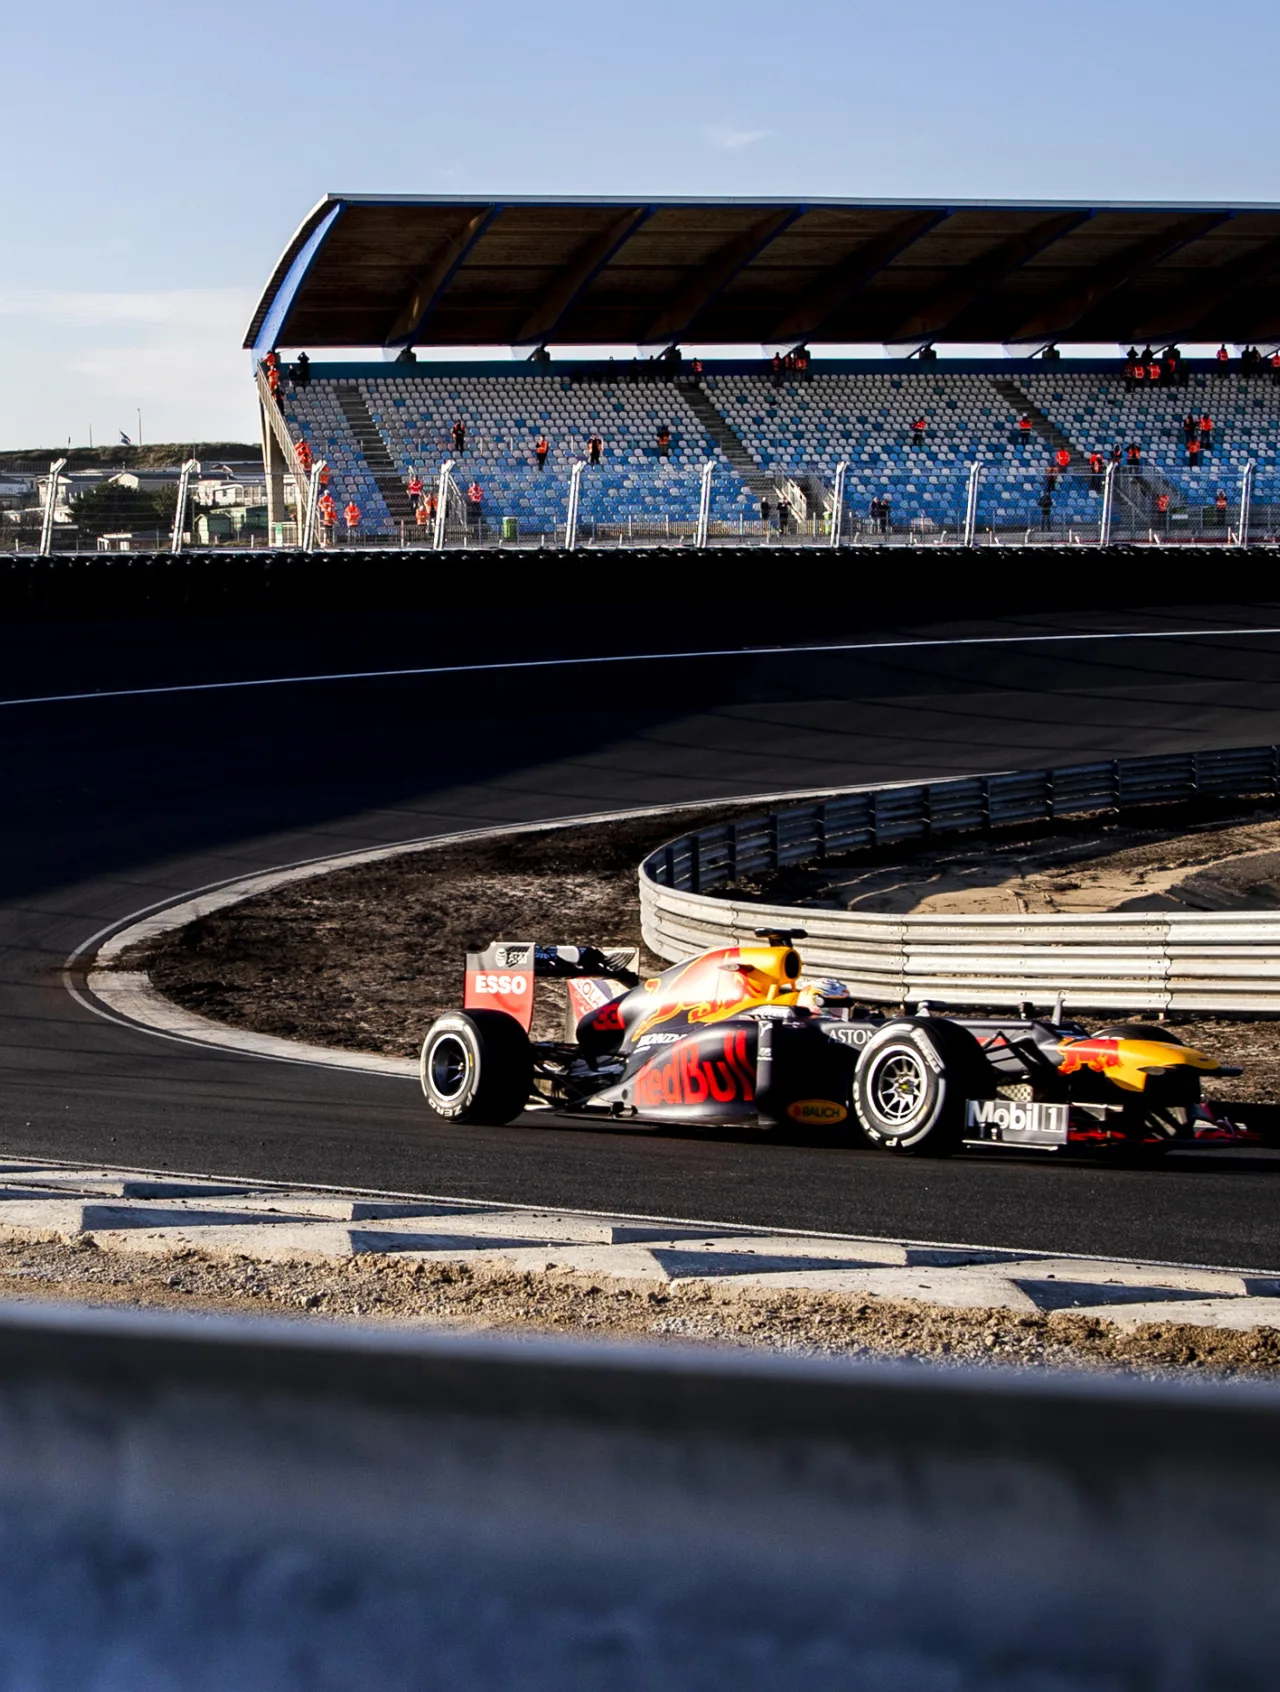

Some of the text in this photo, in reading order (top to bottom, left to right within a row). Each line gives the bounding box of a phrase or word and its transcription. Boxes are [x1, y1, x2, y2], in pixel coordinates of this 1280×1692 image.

[475, 975, 527, 995] ESSO
[802, 1107, 840, 1117] RAUCH
[968, 1100, 1039, 1131] Mobil
